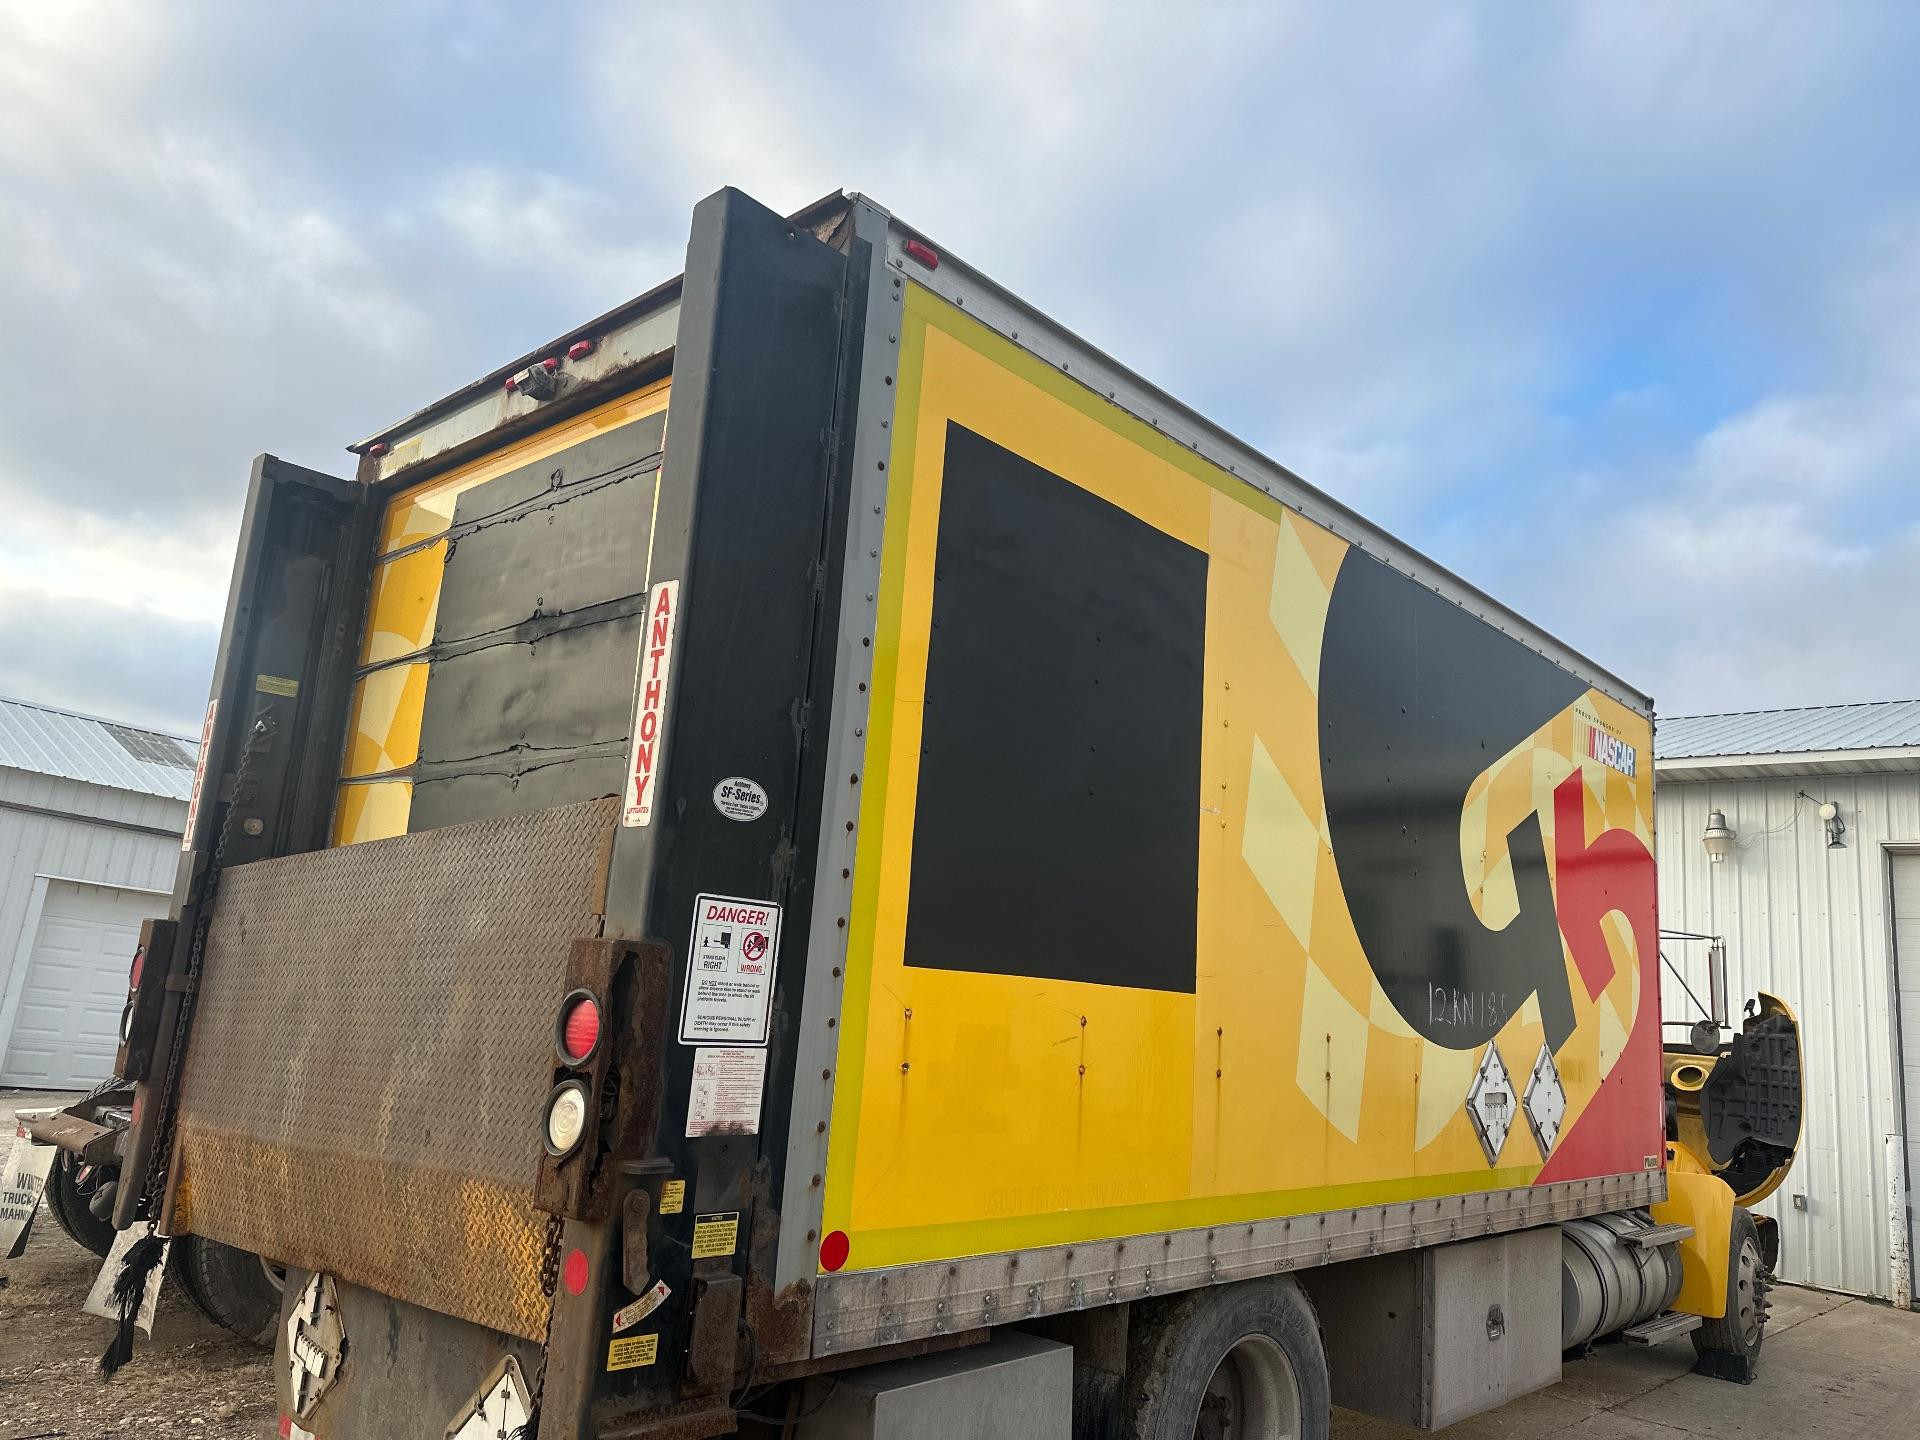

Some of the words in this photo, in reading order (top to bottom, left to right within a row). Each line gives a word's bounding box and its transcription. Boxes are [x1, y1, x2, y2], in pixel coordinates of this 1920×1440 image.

[635, 587, 670, 805] ANTHONY
[1592, 728, 1635, 777] NASCAR
[187, 703, 215, 837] ANTHONY
[721, 786, 761, 804] SF-Series
[706, 905, 770, 926] DANGER!
[703, 960, 723, 970] RIGHT
[740, 963, 763, 973] WRONG
